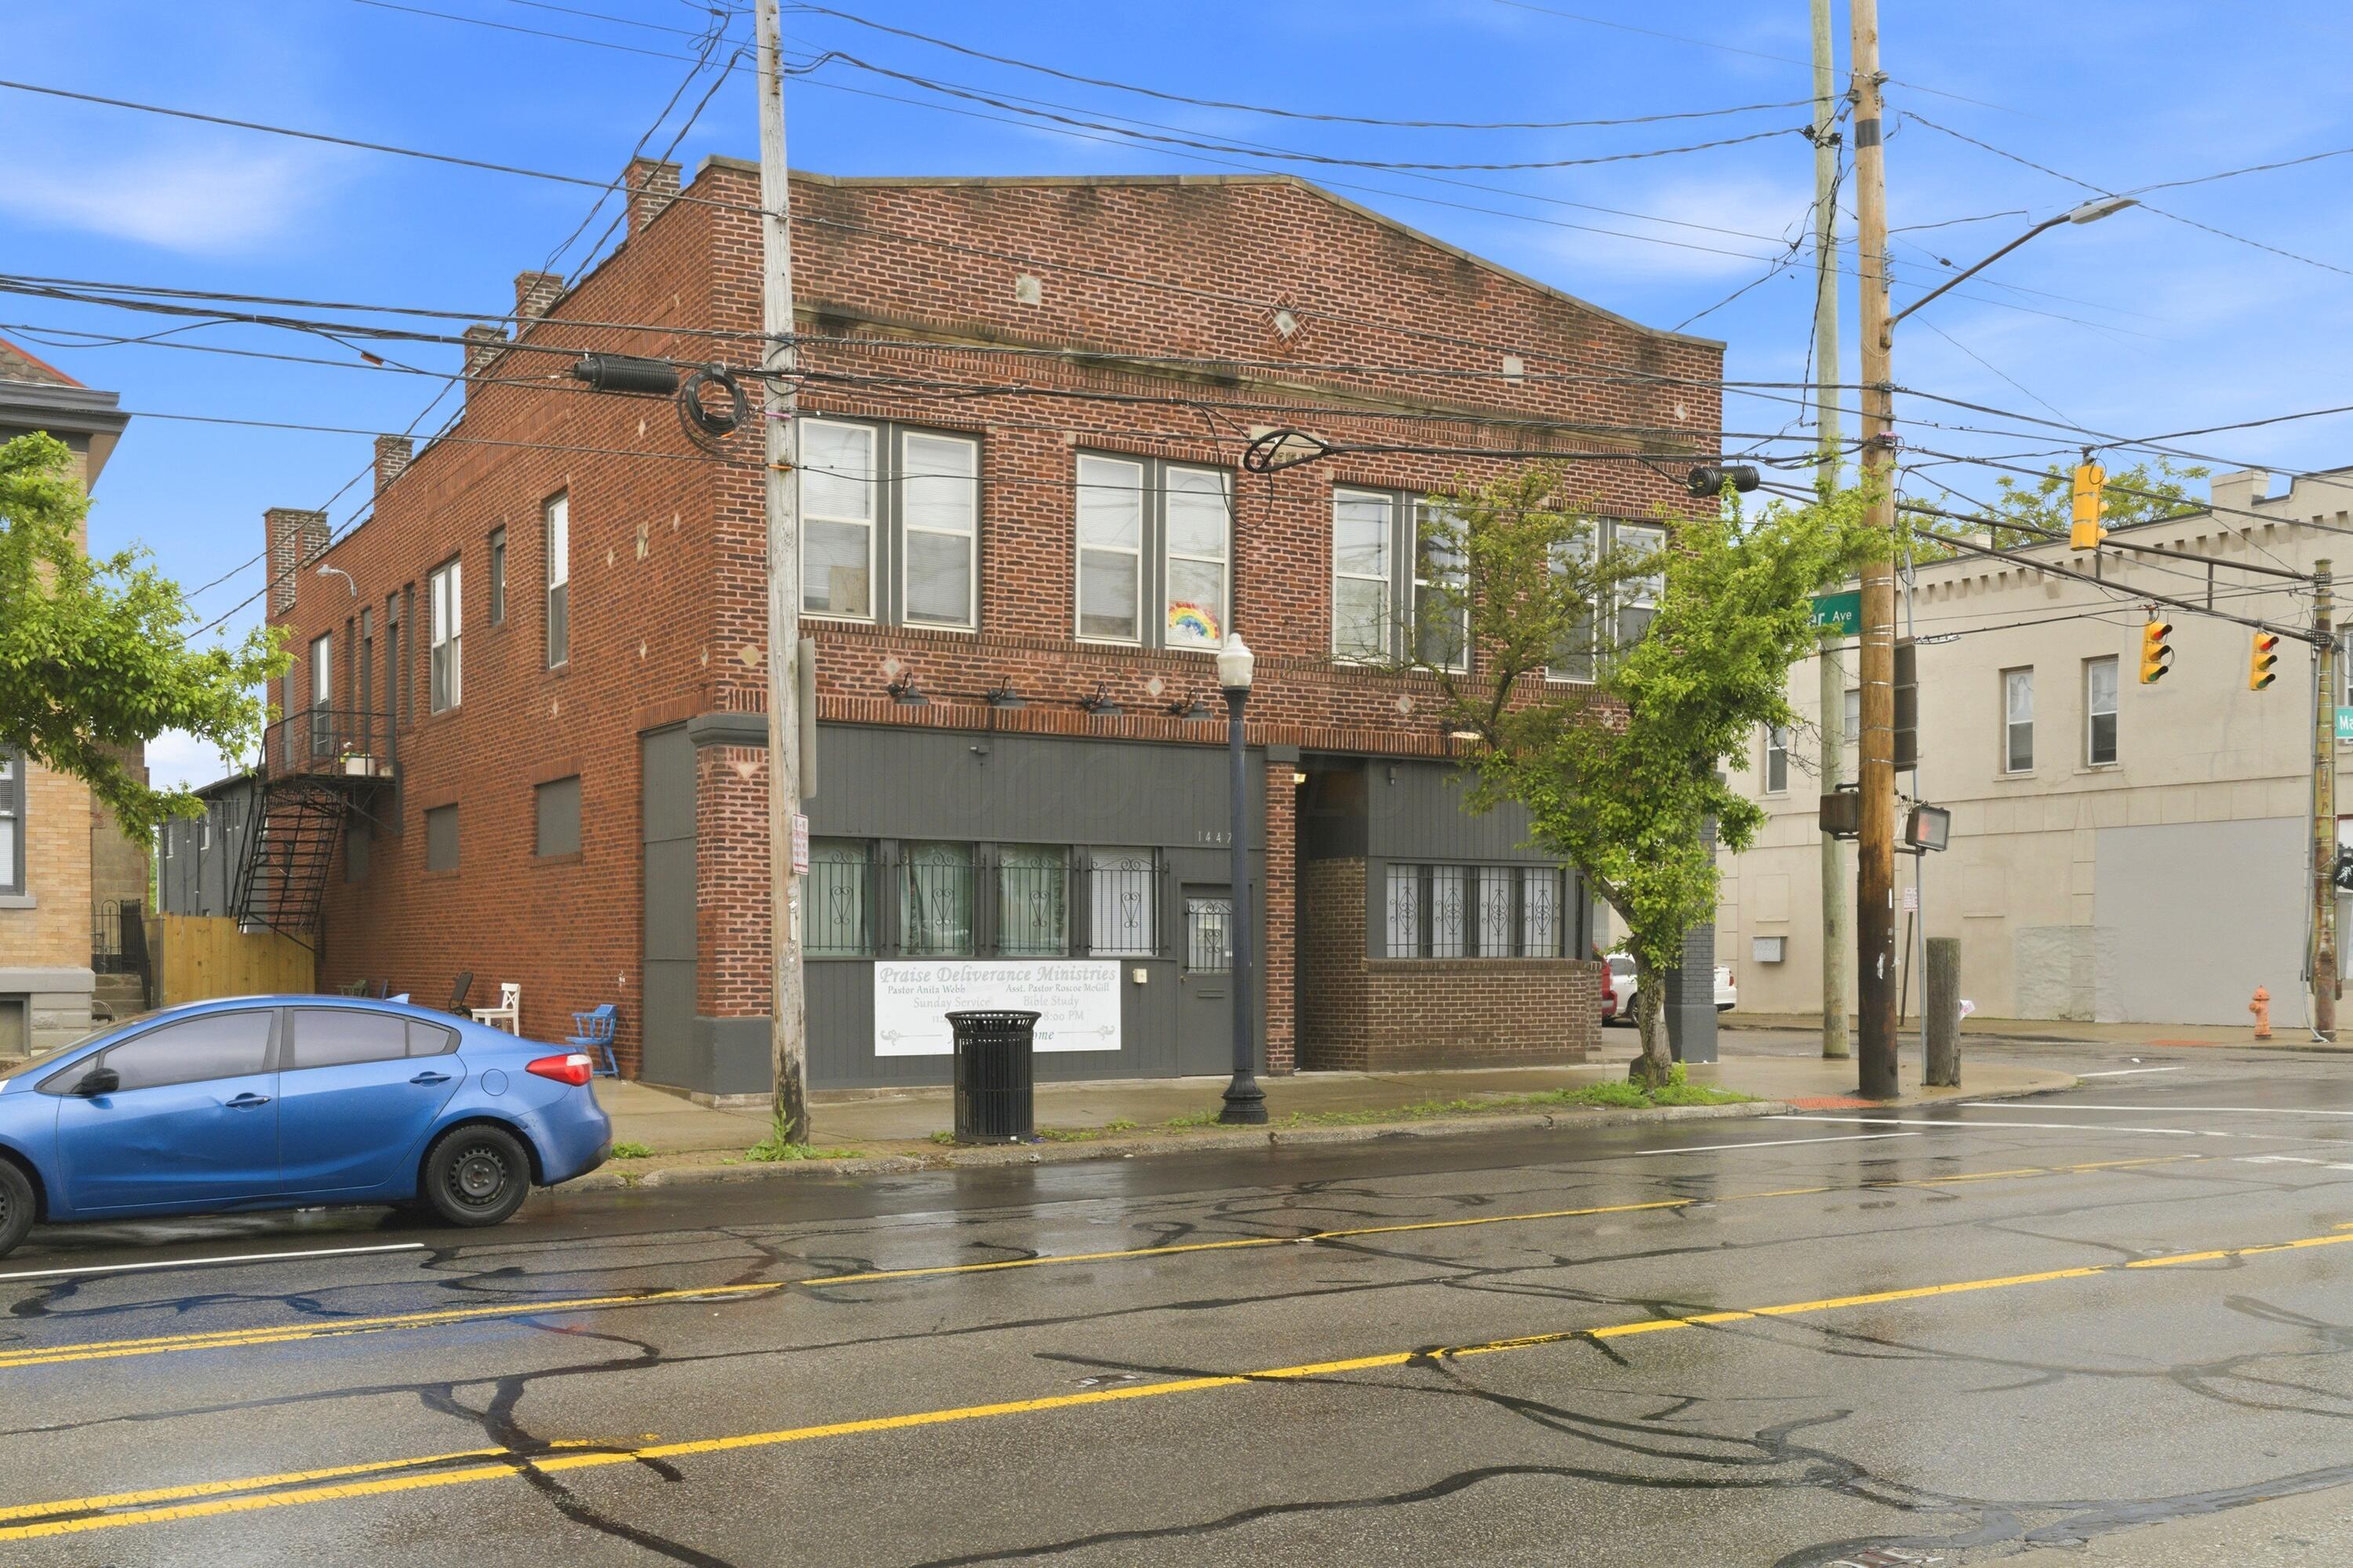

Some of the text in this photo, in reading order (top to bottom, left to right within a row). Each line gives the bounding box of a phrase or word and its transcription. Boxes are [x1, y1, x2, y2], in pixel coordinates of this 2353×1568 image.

[1832, 610, 1852, 622] Ave
[1198, 831, 1231, 843] 1447
[879, 964, 1116, 983] Praise Deliverance Ministries
[888, 984, 966, 995] Pastor Anita Webb
[1006, 984, 1026, 992] Asst.
[1028, 984, 1053, 992] Pastor
[1084, 982, 1110, 991] McGill
[913, 996, 991, 1010] Sunday Service
[1023, 994, 1079, 1009] Bible Study
[1043, 1010, 1085, 1021] 8:00 PM
